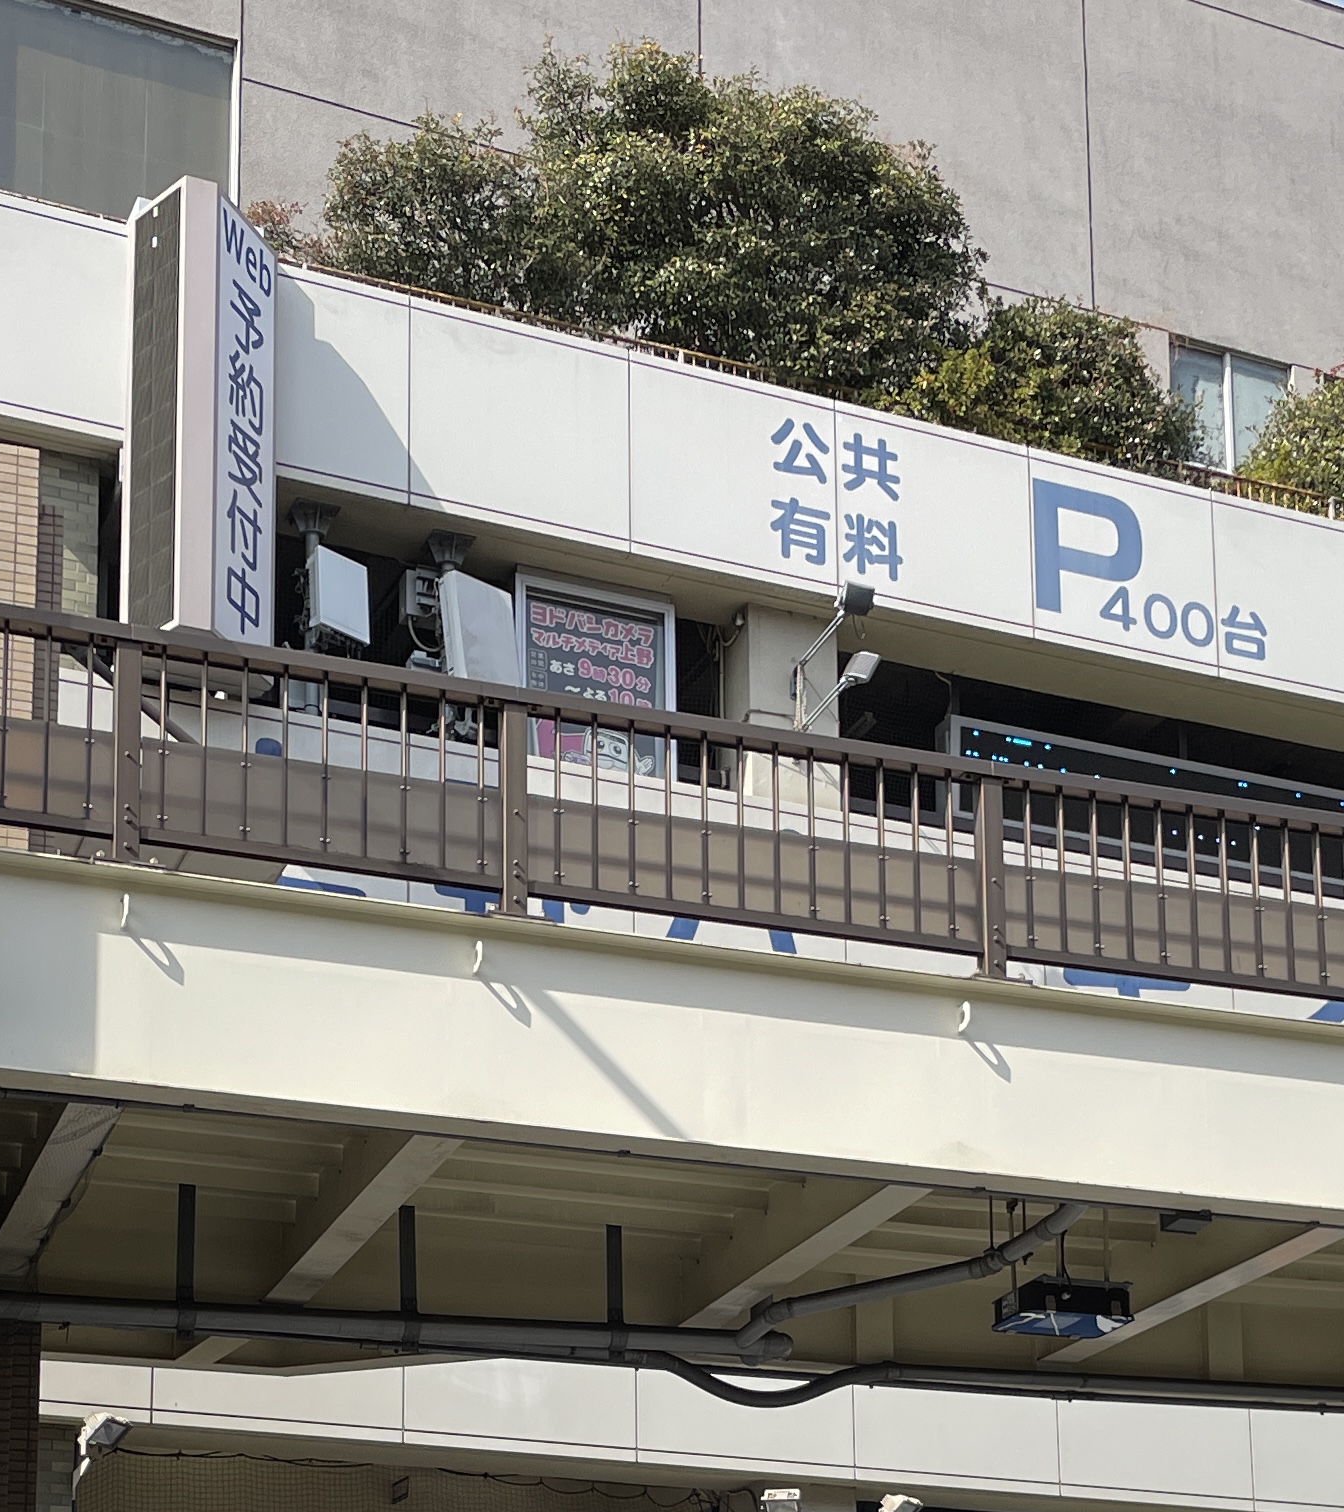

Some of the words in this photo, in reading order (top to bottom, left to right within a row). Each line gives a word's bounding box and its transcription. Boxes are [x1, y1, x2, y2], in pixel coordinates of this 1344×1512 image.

[222, 206, 273, 298] Web
[225, 278, 264, 635] 予約受付中
[769, 417, 901, 502] 公共
[769, 497, 904, 581] 有料
[1032, 478, 1143, 614] P
[530, 602, 654, 647] ヨドバシカメラ
[530, 628, 654, 669] マルチメディア上野
[1099, 585, 1268, 661] 400台
[549, 657, 652, 693] あさ9時30分
